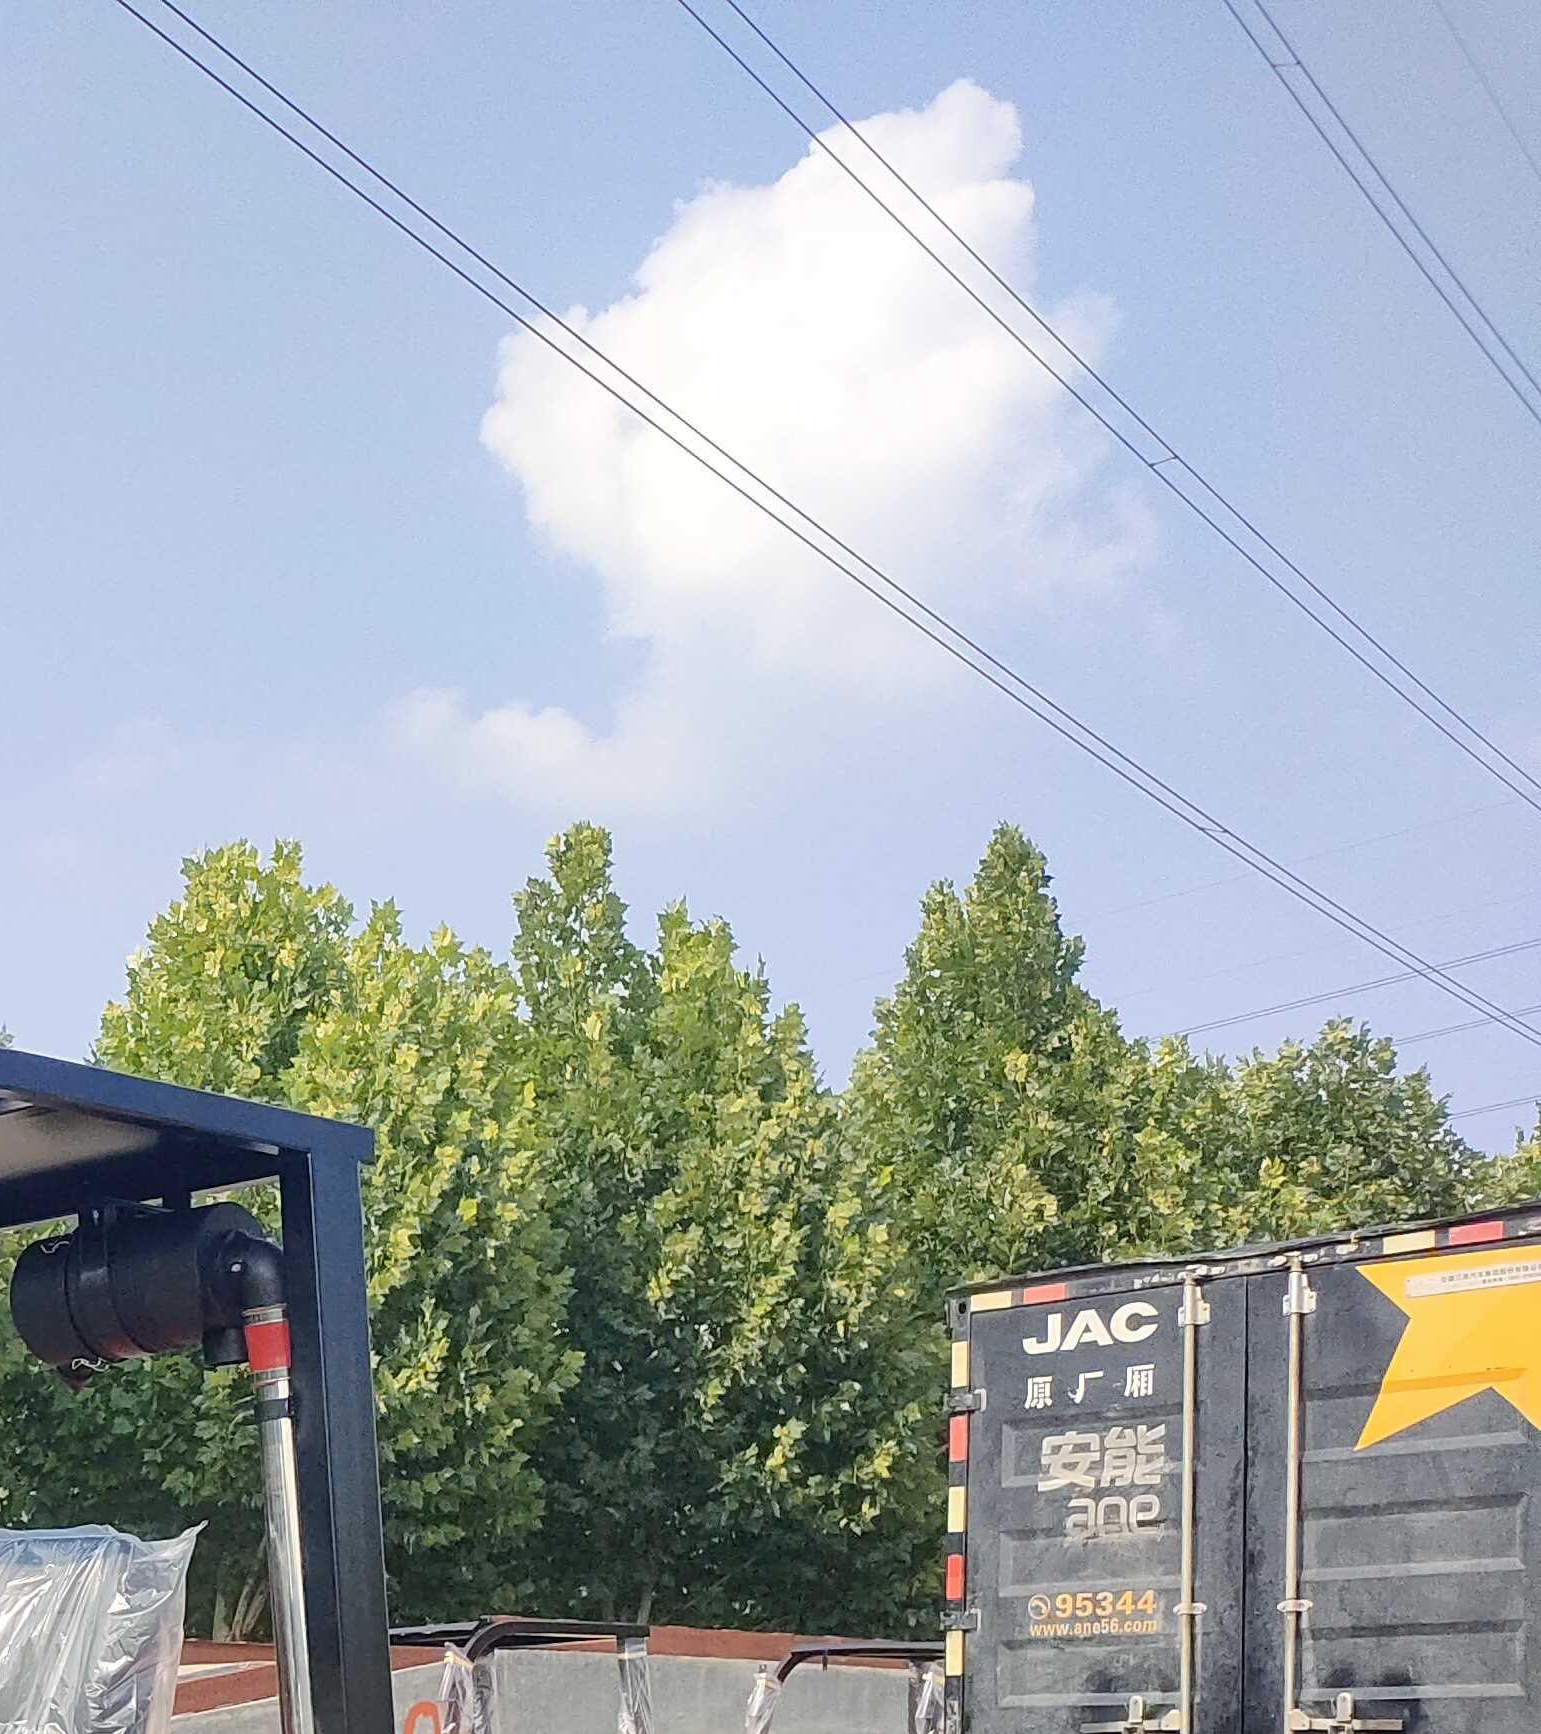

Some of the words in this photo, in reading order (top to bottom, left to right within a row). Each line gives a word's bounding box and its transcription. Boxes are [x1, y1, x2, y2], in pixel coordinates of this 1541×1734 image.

[1022, 1301, 1159, 1355] JAC
[1024, 1363, 1156, 1409] 原厂厢
[1037, 1423, 1166, 1492] 安能
[1055, 1589, 1157, 1618] 95344
